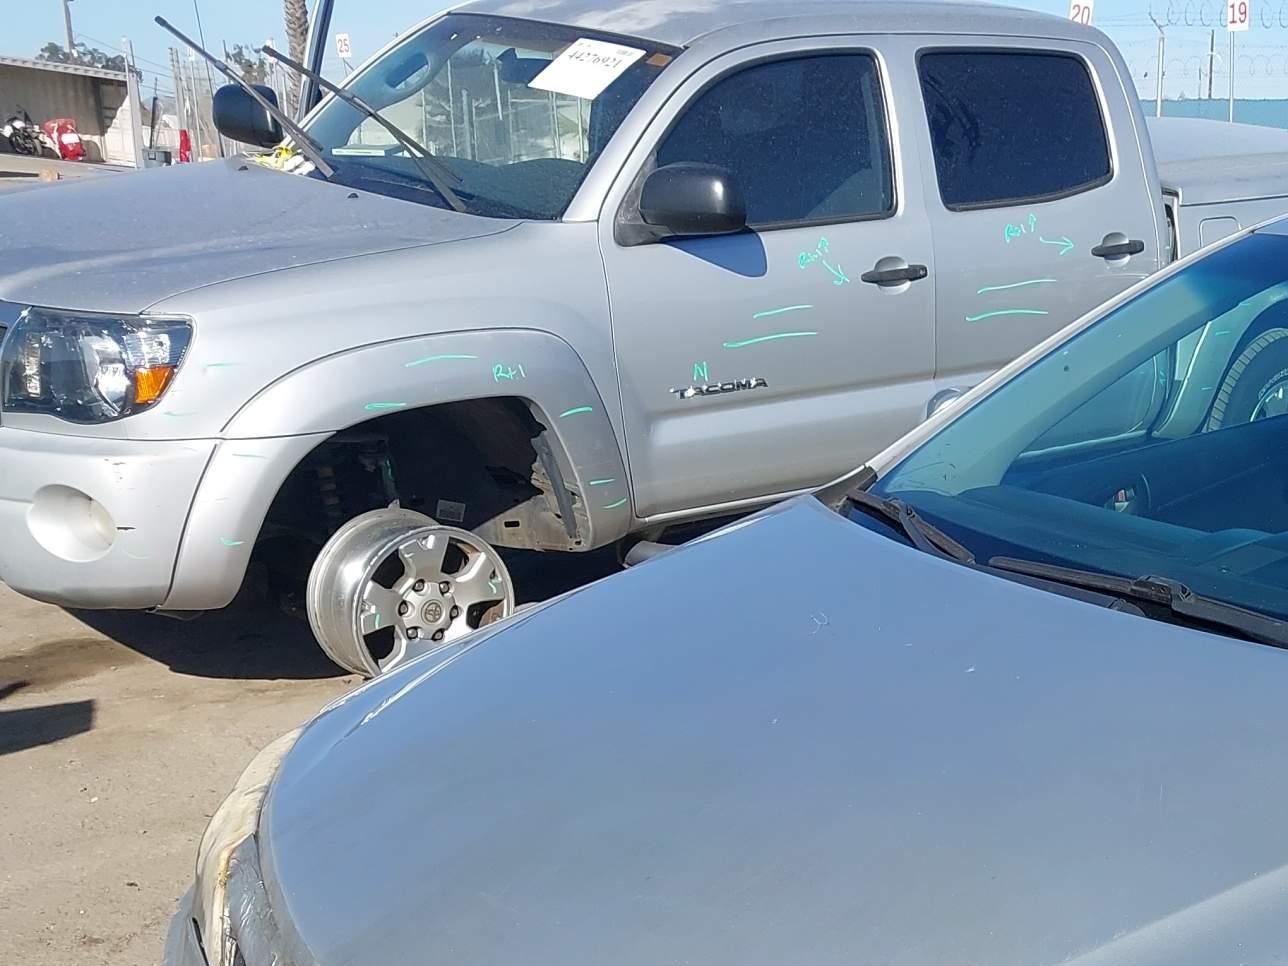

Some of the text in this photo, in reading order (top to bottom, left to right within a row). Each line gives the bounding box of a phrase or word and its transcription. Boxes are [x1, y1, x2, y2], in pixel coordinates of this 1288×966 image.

[1072, 4, 1090, 24] 20
[1229, 2, 1247, 24] 19
[337, 38, 350, 53] 25
[669, 377, 769, 400] TACOMA
